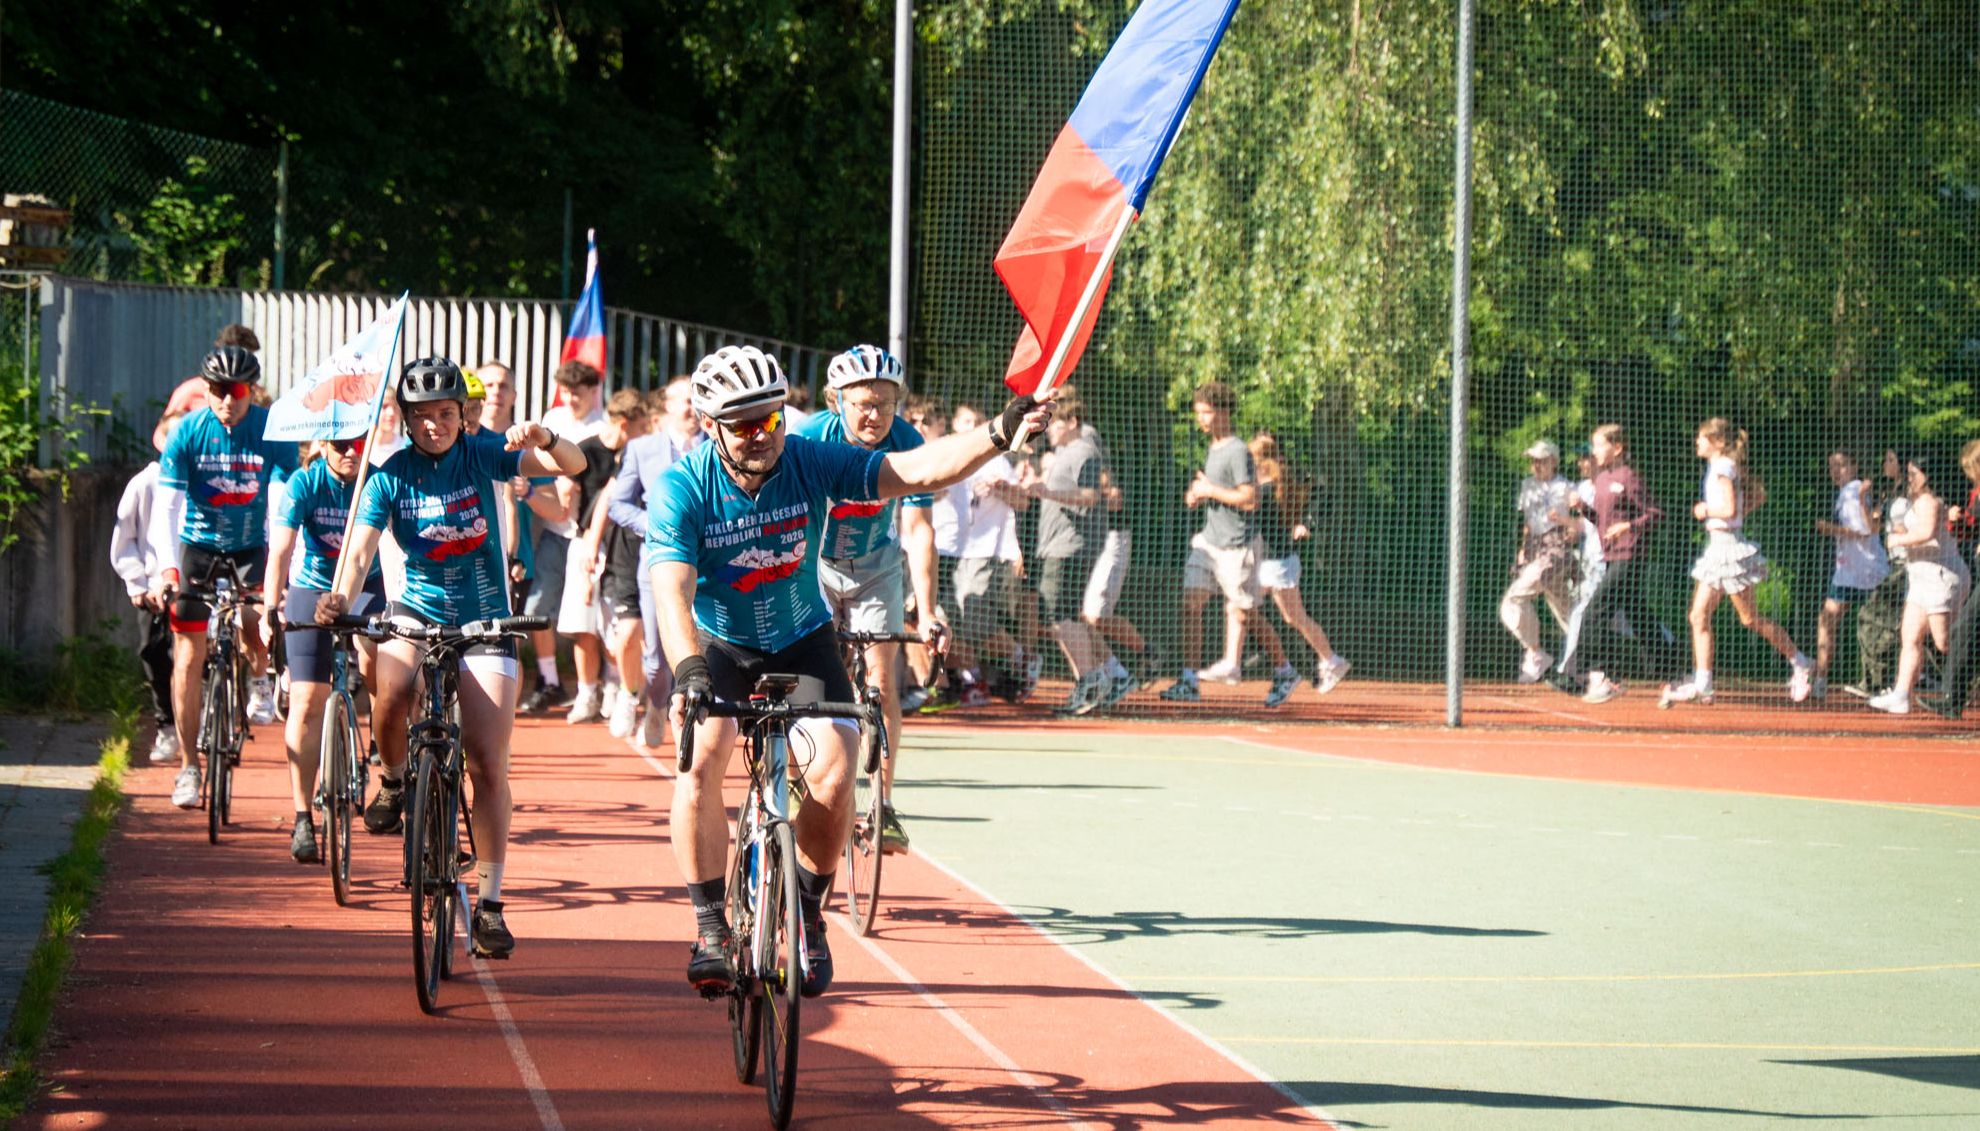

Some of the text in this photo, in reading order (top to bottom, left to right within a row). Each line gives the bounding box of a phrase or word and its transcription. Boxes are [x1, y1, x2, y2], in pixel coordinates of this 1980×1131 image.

[758, 511, 771, 524] ZA
[705, 526, 762, 549] REPUBLIKU
[780, 529, 804, 545] 2026
